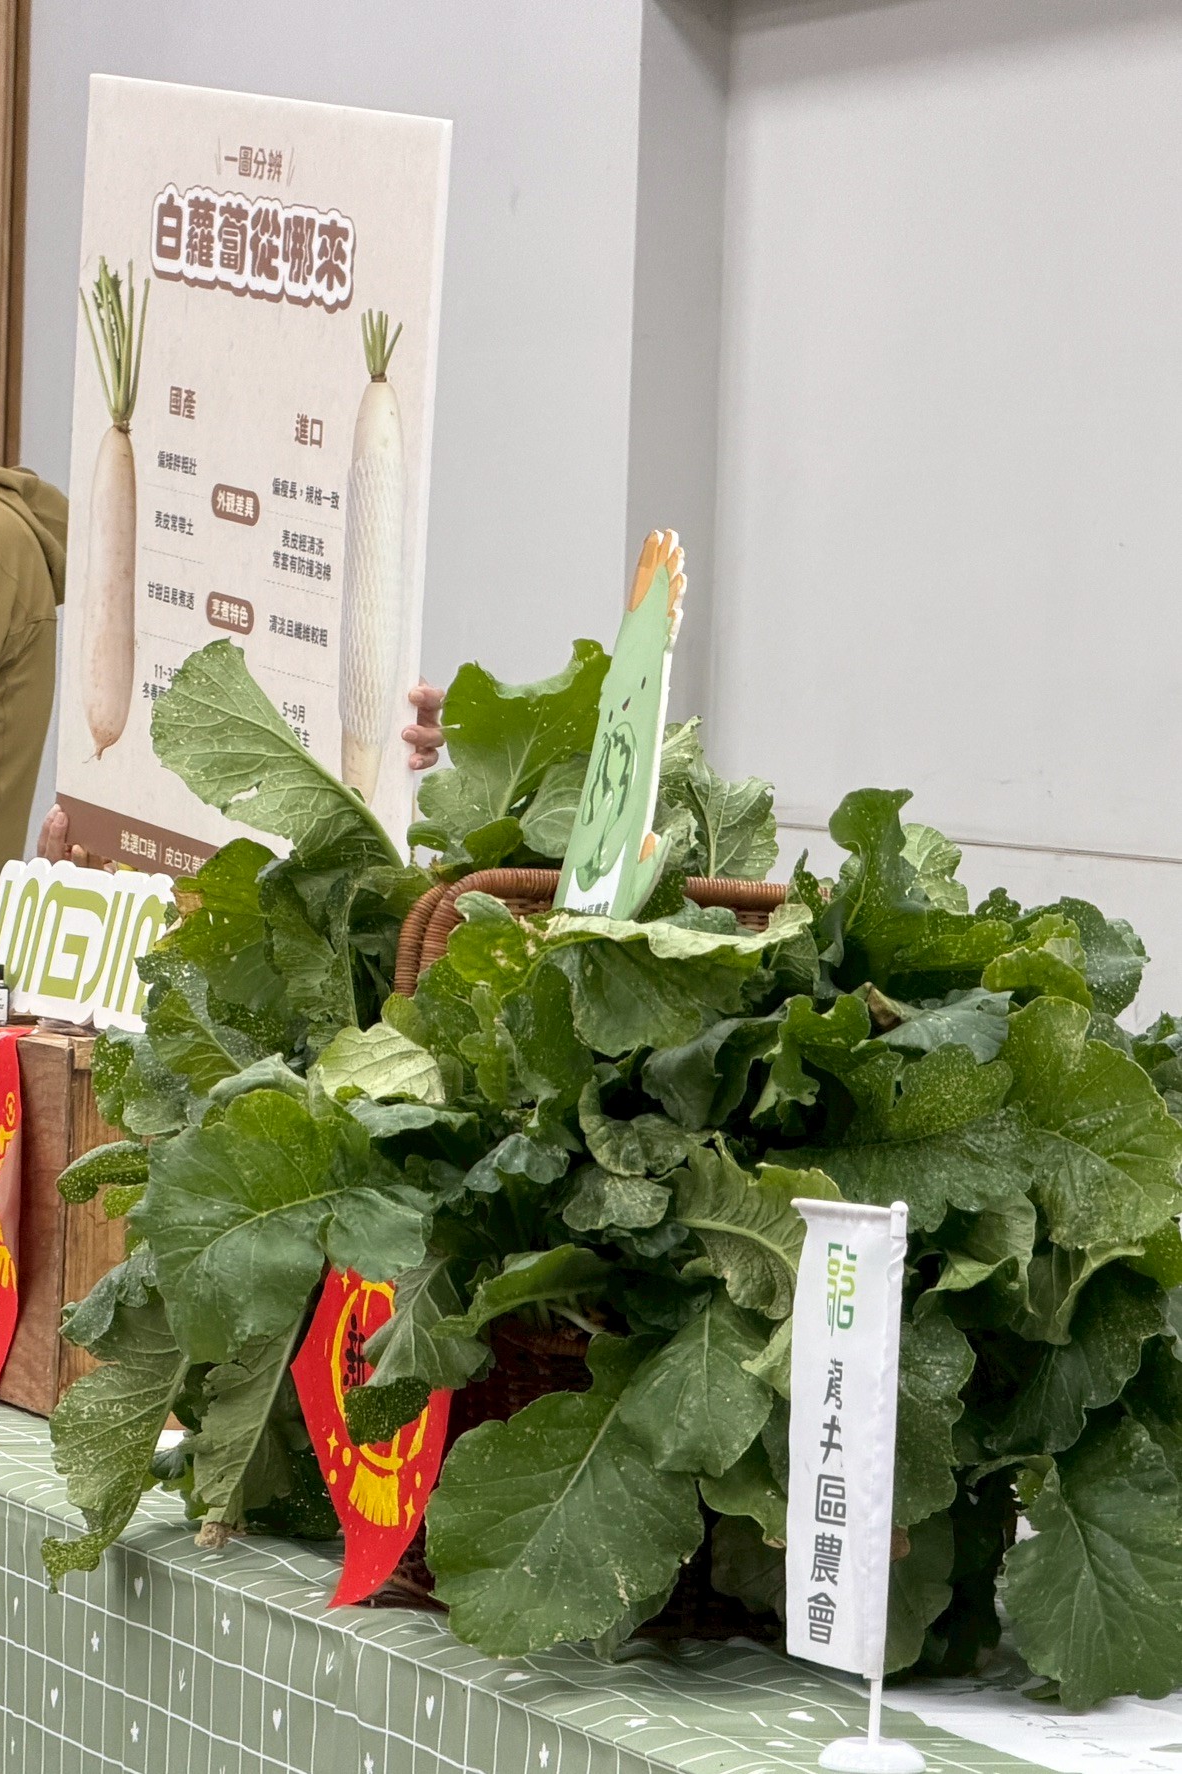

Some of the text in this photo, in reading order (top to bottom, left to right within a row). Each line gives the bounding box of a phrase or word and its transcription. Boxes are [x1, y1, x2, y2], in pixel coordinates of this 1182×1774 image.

[224, 146, 282, 181] 一圖分辨
[155, 193, 350, 292] 白蘿蔔從哪來
[169, 386, 196, 420] 國產
[294, 413, 323, 448] 進口
[217, 490, 254, 519] 外觀差異
[154, 510, 194, 536] 表皮常帶土
[281, 529, 325, 557] 表皮經清洗
[211, 598, 249, 628] 烹煮特色
[269, 614, 328, 648] 清淡且纖維較粗
[120, 830, 157, 861] 挑選口訣
